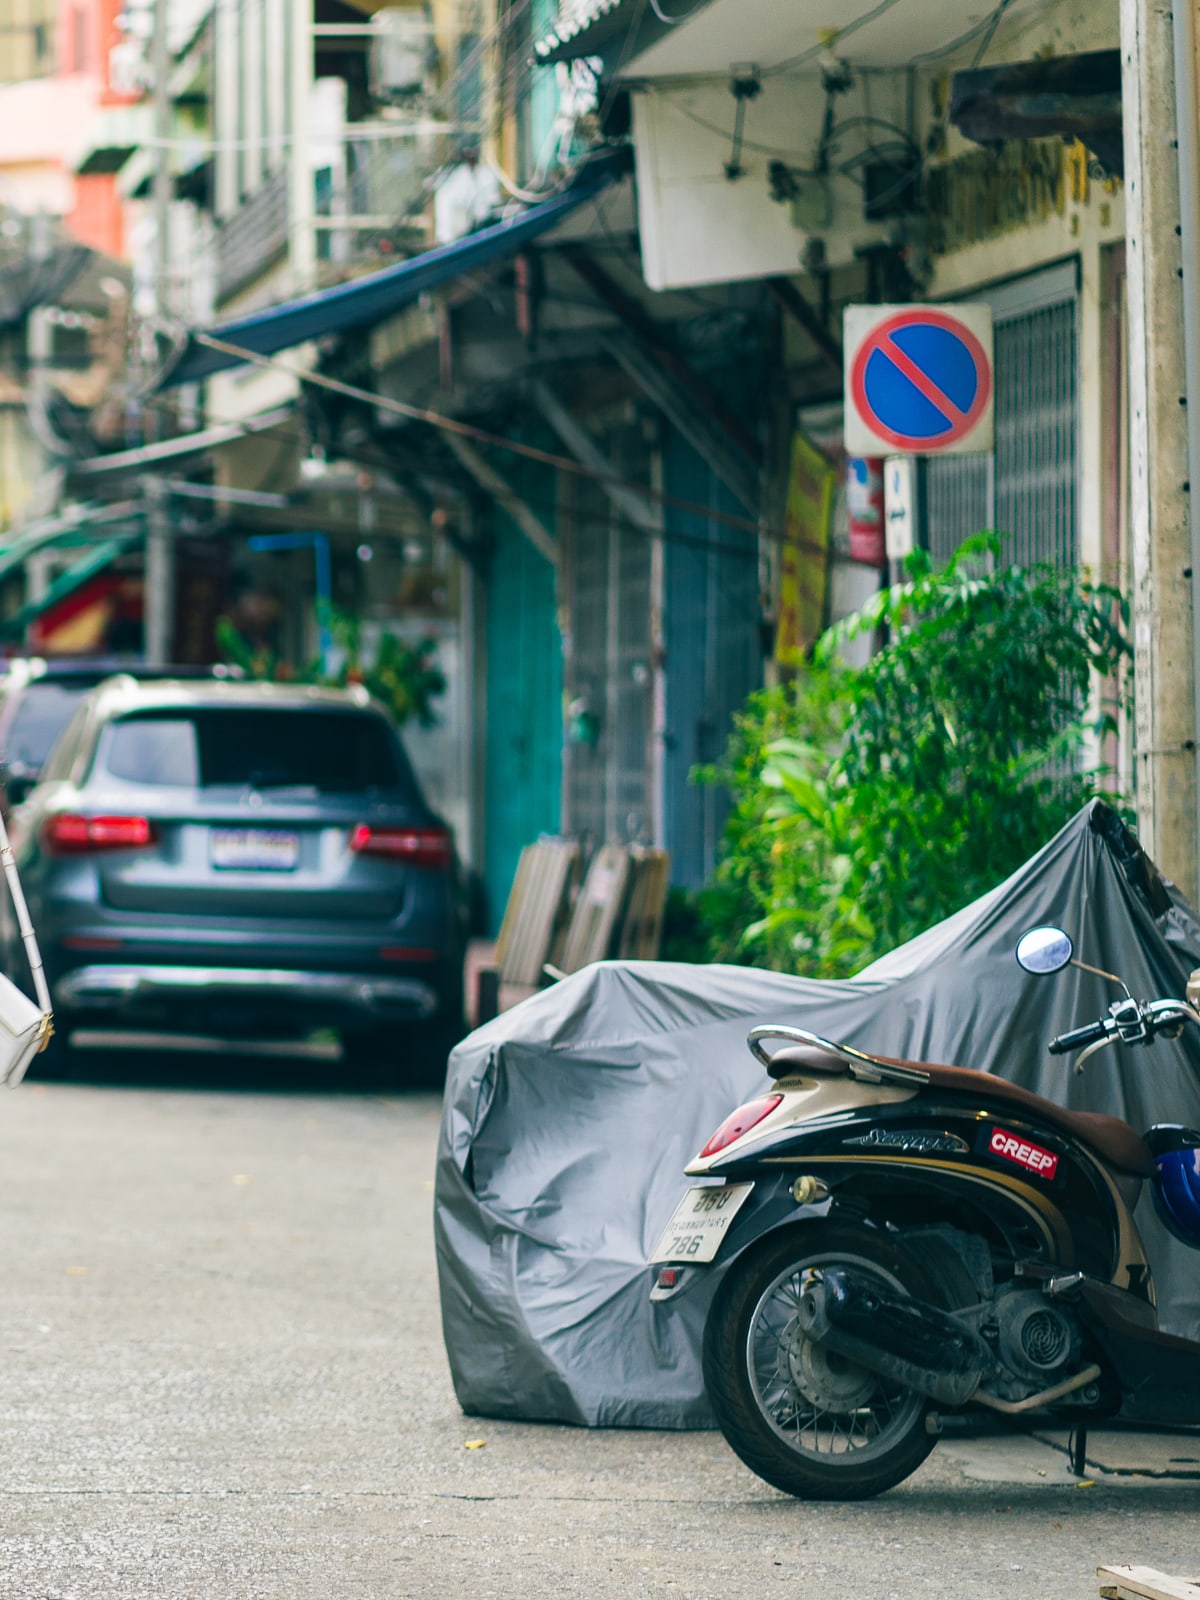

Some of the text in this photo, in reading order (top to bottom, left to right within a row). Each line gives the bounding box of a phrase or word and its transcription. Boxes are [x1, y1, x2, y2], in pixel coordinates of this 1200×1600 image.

[779, 1080, 803, 1088] HONDA
[991, 1133, 1053, 1170] CREEP
[665, 1235, 704, 1256] 786
